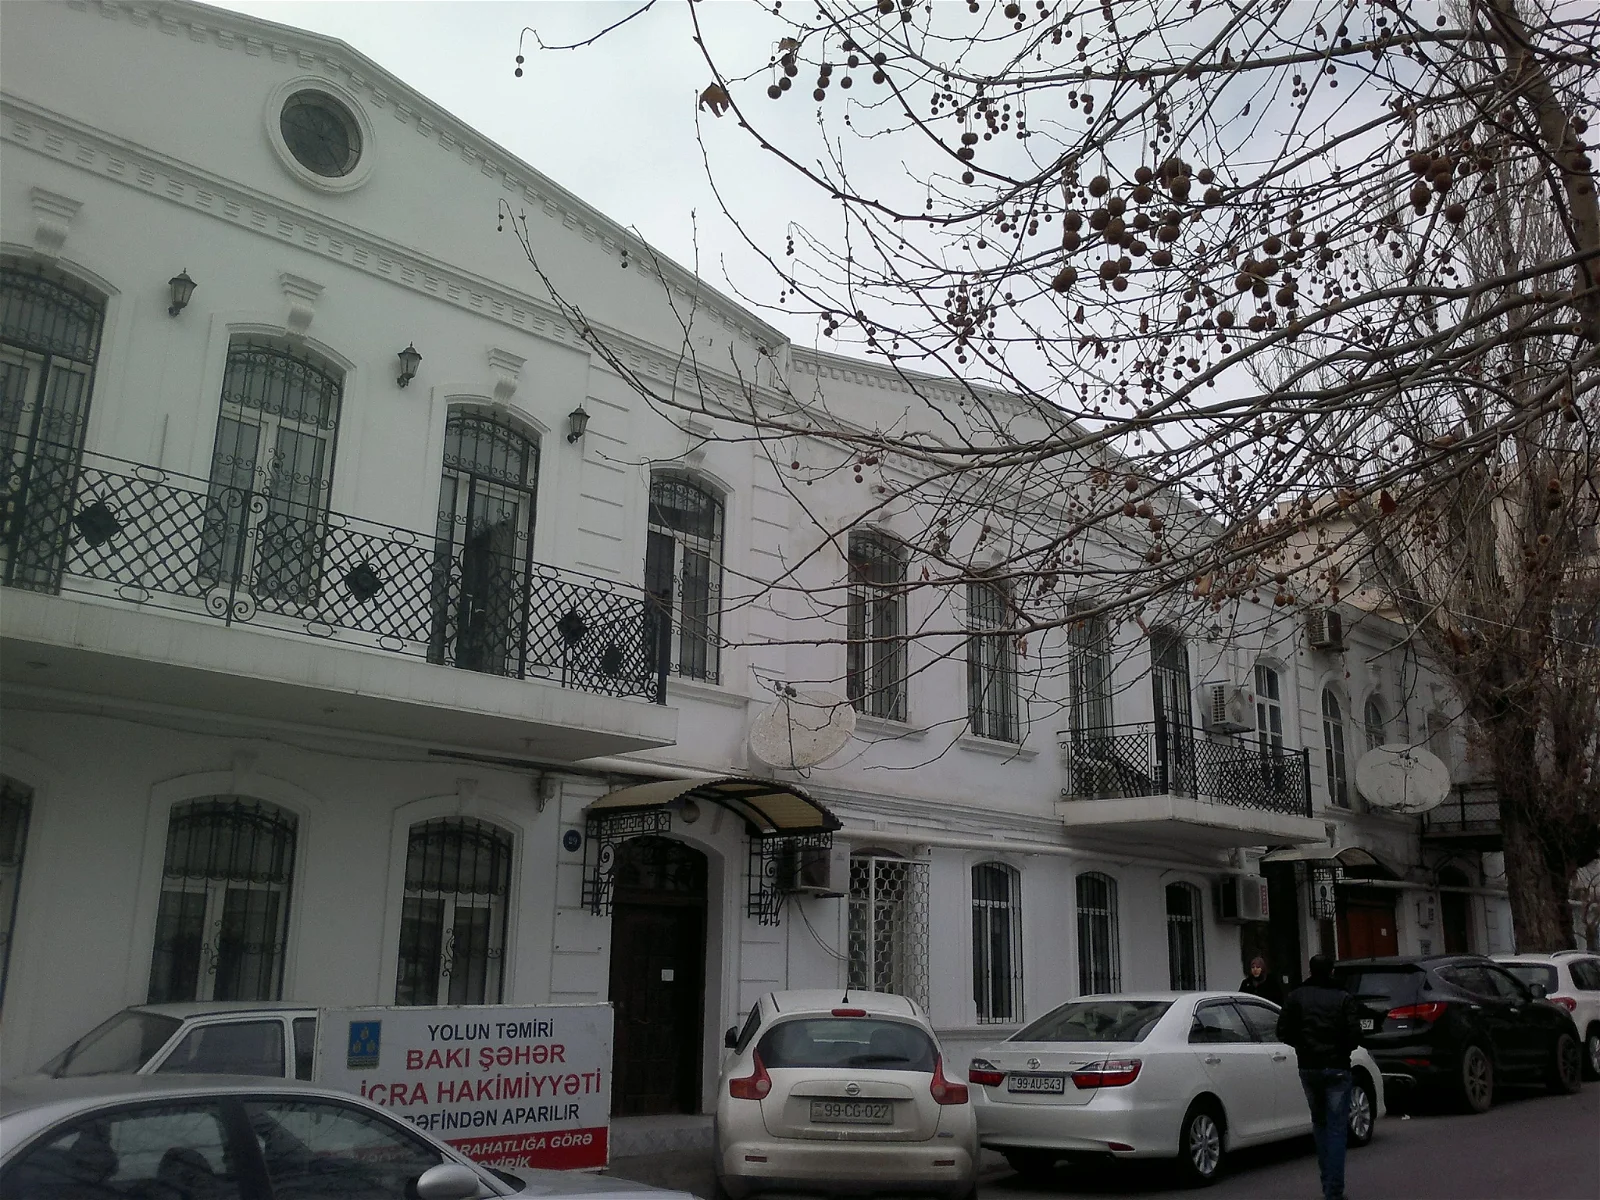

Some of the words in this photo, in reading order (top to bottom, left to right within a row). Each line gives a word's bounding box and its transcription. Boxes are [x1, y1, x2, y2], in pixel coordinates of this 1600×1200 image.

[427, 1023, 490, 1042] YOLUN
[495, 1018, 554, 1039] TƏMİRİ
[406, 1047, 470, 1071] BAKI
[478, 1044, 566, 1072] ŞƏHƏR
[360, 1080, 429, 1107] İCRA
[437, 1068, 601, 1104] HAKİMİYYƏTİ
[1016, 1078, 1061, 1091] 99-AU-543
[502, 1104, 579, 1126] APARILIR
[824, 1103, 889, 1118] 99-CG-027
[454, 1136, 547, 1156] RAHATLIĞA
[549, 1133, 593, 1149] GÖRƏ
